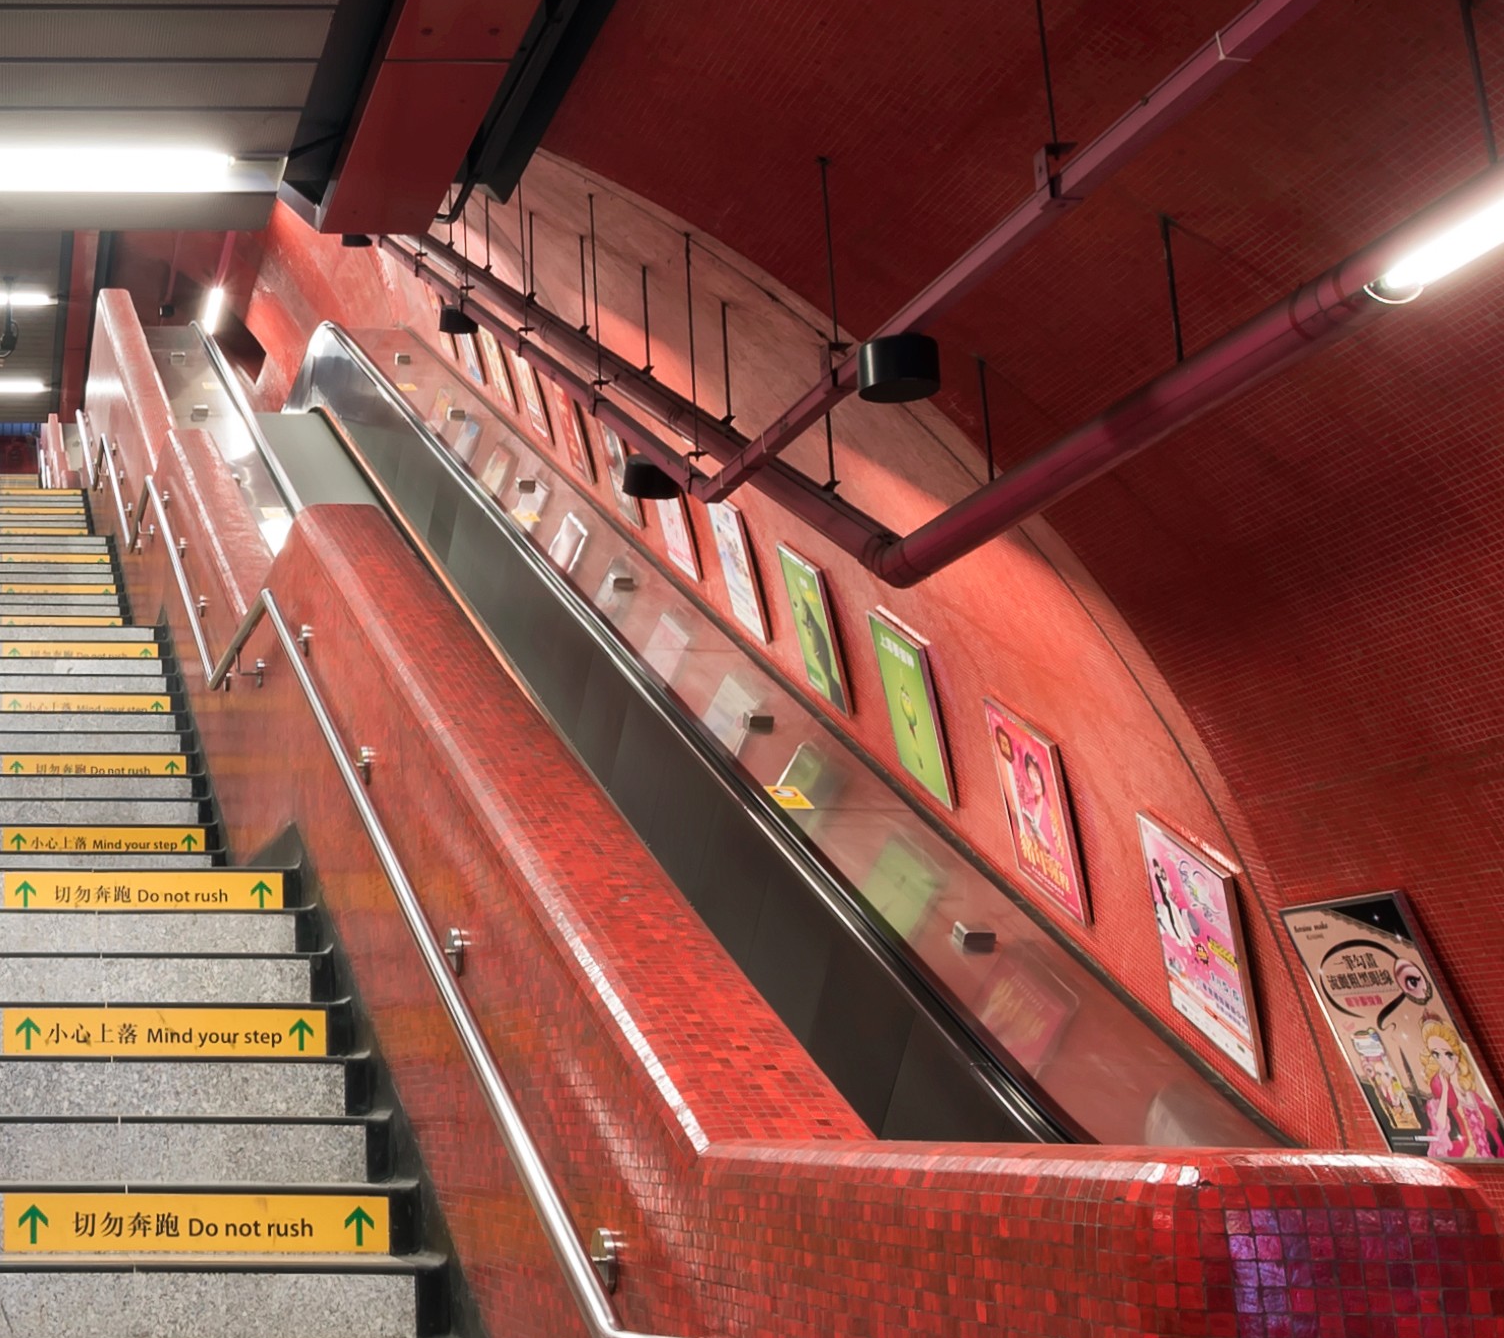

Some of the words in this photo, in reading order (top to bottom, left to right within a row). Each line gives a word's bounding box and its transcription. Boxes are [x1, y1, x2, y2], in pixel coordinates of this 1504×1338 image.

[35, 762, 87, 775] 切勿奔跑
[90, 765, 106, 775] Do
[107, 766, 125, 775] not
[127, 765, 151, 775] rush
[30, 836, 87, 851] 小心上落
[92, 839, 122, 850] Mind
[124, 841, 151, 852] your
[153, 840, 178, 852] step
[54, 885, 132, 904] 切勿奔跑
[137, 889, 160, 903] Do
[164, 890, 190, 903] not
[194, 889, 229, 903] rush
[48, 1022, 139, 1045] 小心上落
[146, 1027, 194, 1044] Mind
[198, 1032, 240, 1049] your
[244, 1031, 283, 1049] step
[73, 1212, 180, 1238] 切勿奔跑
[189, 1218, 219, 1237] Do
[225, 1220, 261, 1237] not
[267, 1218, 313, 1237] rush
